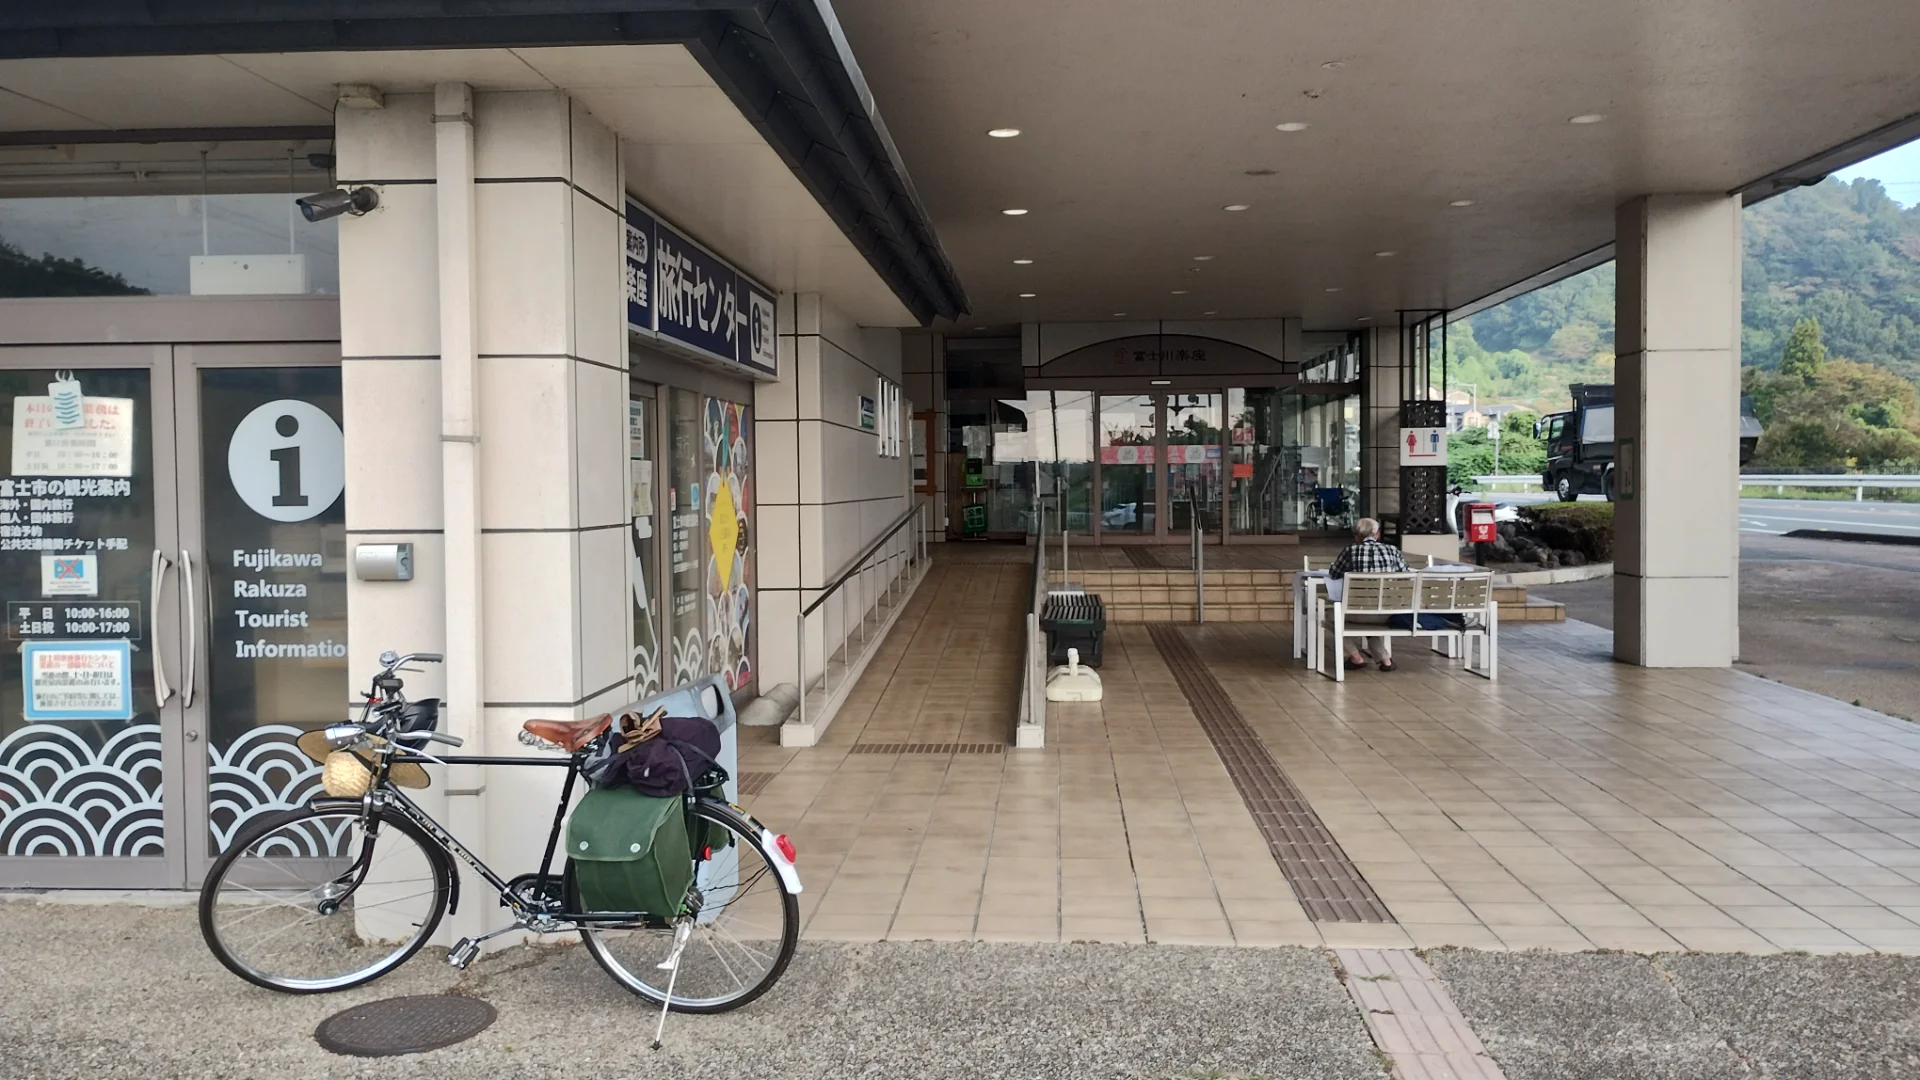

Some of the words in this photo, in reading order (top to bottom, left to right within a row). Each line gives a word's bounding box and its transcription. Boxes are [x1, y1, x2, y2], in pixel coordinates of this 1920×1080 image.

[657, 238, 748, 343] 旅行センター
[1132, 349, 1207, 363] 富士川楽座
[0, 478, 131, 498] 富士市の観光案内
[0, 525, 43, 538] 宿泊予約
[233, 548, 323, 572] Fujikawa
[233, 579, 307, 598] Rakuza
[65, 607, 130, 619] 10:00-16:00
[235, 610, 308, 628] Tourist
[19, 621, 55, 634] 土日祝
[65, 621, 131, 633] 10:00-17:00
[235, 640, 348, 658] Informatio
